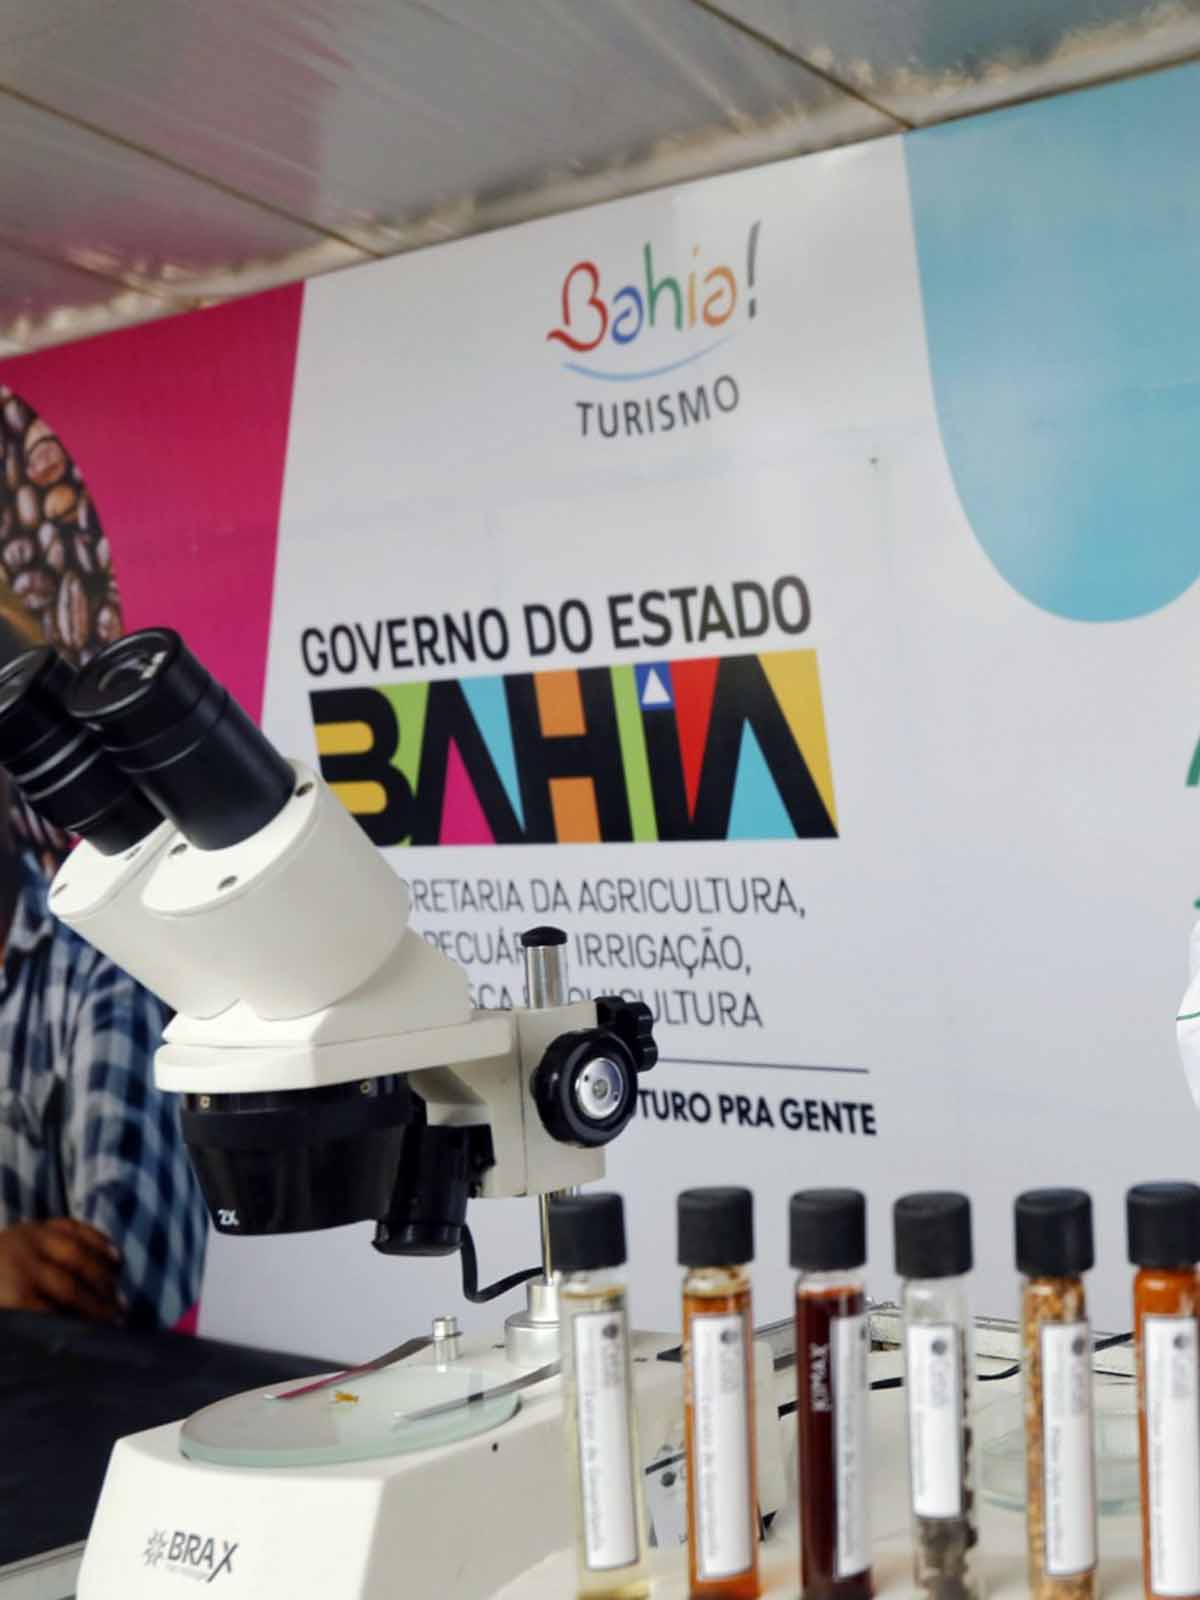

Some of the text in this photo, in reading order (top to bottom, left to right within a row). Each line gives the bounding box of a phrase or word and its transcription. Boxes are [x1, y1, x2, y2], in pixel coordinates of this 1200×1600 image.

[546, 220, 761, 353] Bahia!
[576, 375, 739, 438] TURISMO
[300, 574, 812, 677] GOVERNO DO ESTADO
[308, 650, 840, 847] BAHIA
[408, 876, 806, 918] RETARIA DA AGRICULTURA,
[576, 927, 752, 977] IRRIGAÇÃO,
[638, 1088, 877, 1136] TURO PRA GENTE
[168, 1530, 239, 1583] BRAX
